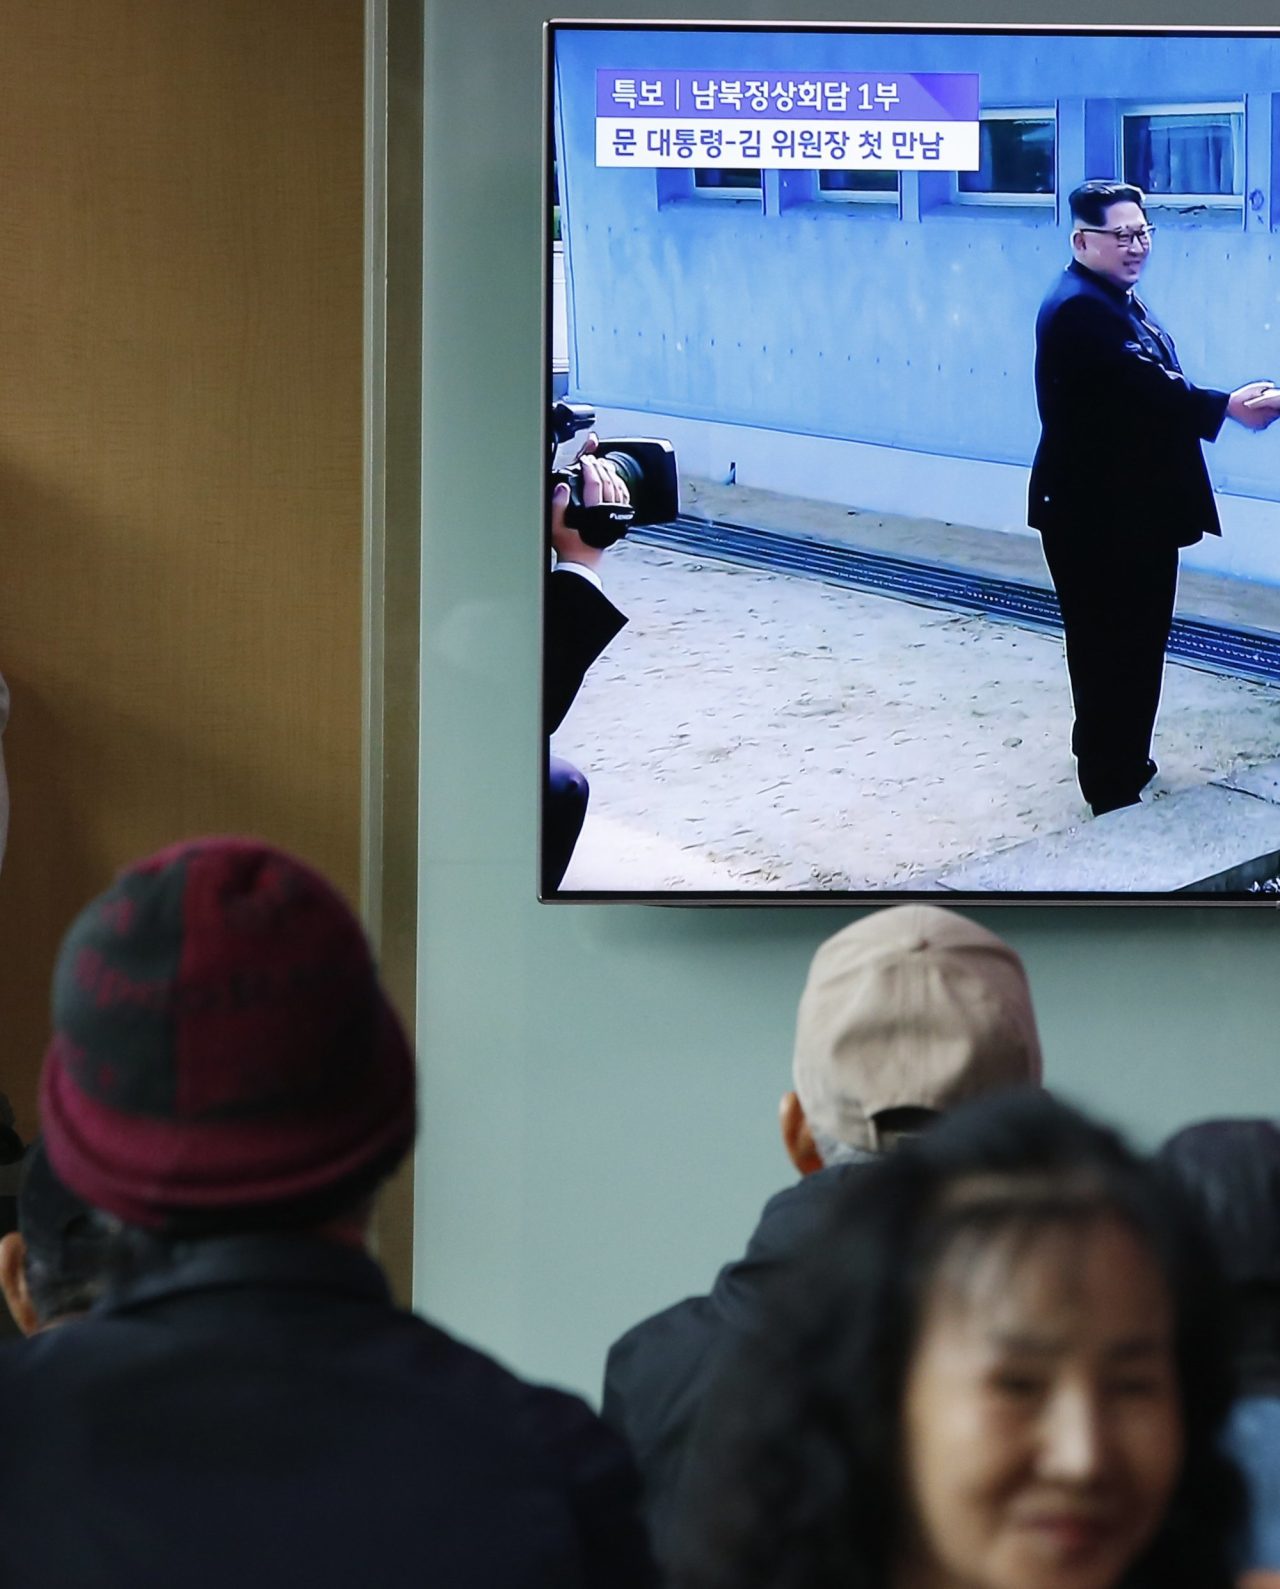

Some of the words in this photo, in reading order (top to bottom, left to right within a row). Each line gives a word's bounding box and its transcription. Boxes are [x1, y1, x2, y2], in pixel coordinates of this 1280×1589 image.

[612, 78, 664, 110] 특보
[691, 80, 850, 112] 남북정상회담
[857, 83, 900, 112] 1부
[612, 127, 637, 157] 문
[646, 128, 762, 159] 대통령-김
[771, 130, 850, 160] 위원장
[858, 130, 883, 160] 첫
[891, 130, 945, 161] 만남
